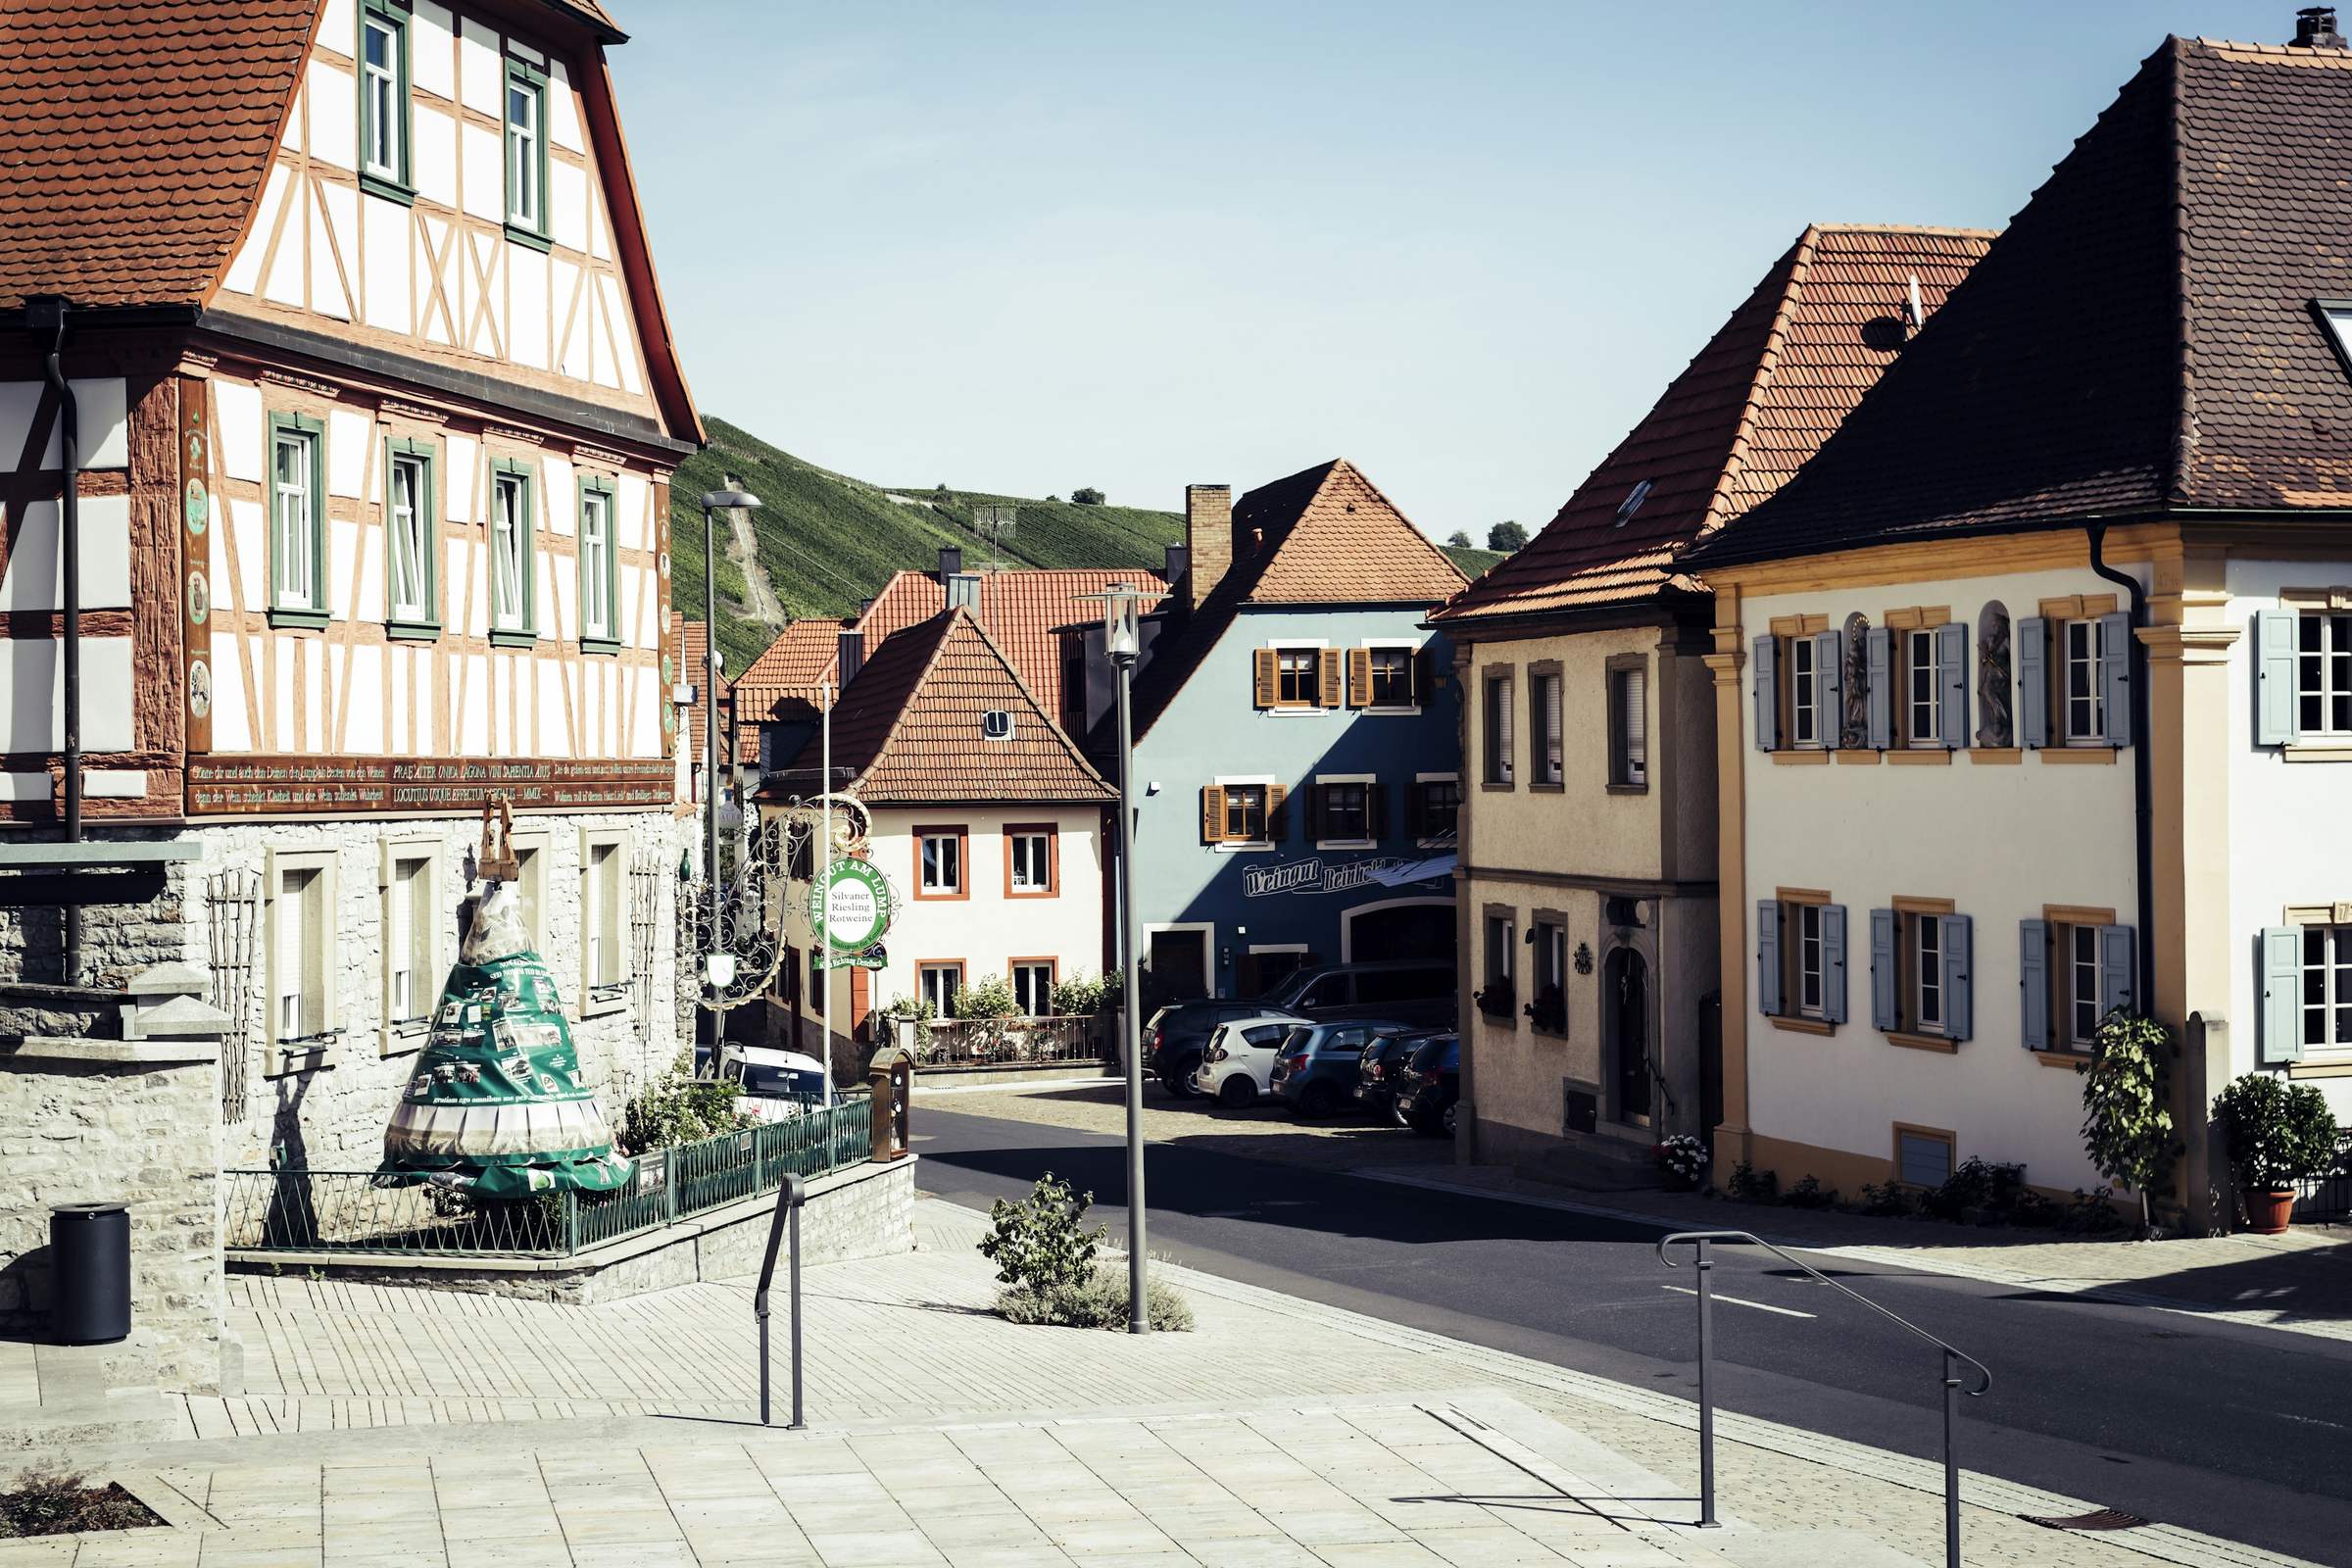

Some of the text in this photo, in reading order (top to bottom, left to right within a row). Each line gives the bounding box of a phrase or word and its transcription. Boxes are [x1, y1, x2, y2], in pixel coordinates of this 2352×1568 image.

[1247, 860, 1319, 895] Weingut
[850, 860, 873, 877] AM
[871, 876, 888, 918] LUMP
[831, 891, 869, 901] Silvaner
[831, 903, 870, 913] Riesling
[829, 913, 873, 923] Rotweine
